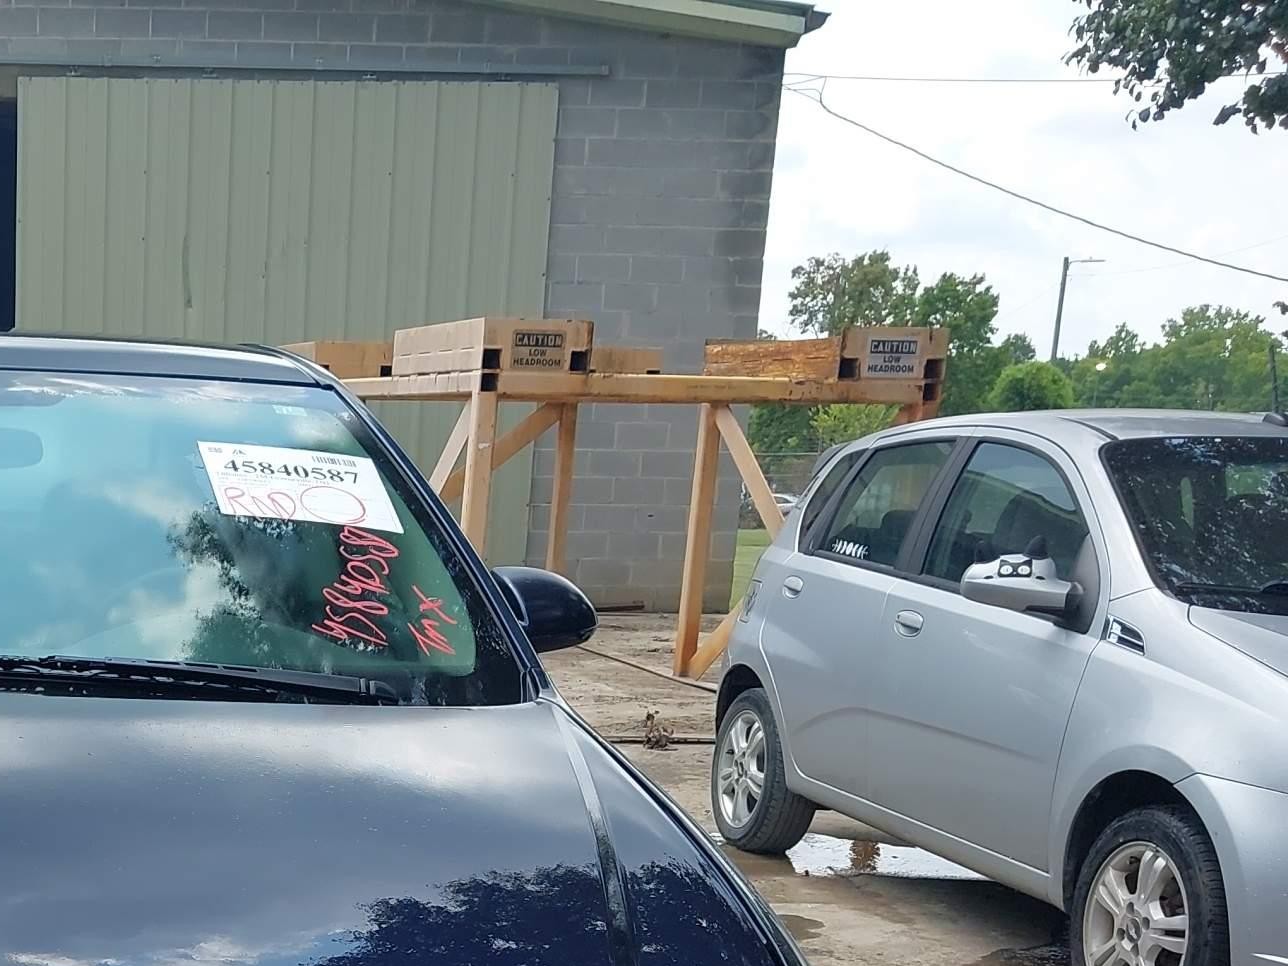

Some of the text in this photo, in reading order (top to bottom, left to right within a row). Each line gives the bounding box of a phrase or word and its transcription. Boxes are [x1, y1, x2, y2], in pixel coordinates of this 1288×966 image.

[516, 334, 562, 346] CAUTION
[871, 341, 917, 353] CAUTION
[528, 348, 548, 357] LOW
[513, 357, 561, 367] HEADROOM
[883, 355, 902, 364] LOW
[867, 364, 914, 373] HEADROOM
[224, 459, 359, 484] 45840587
